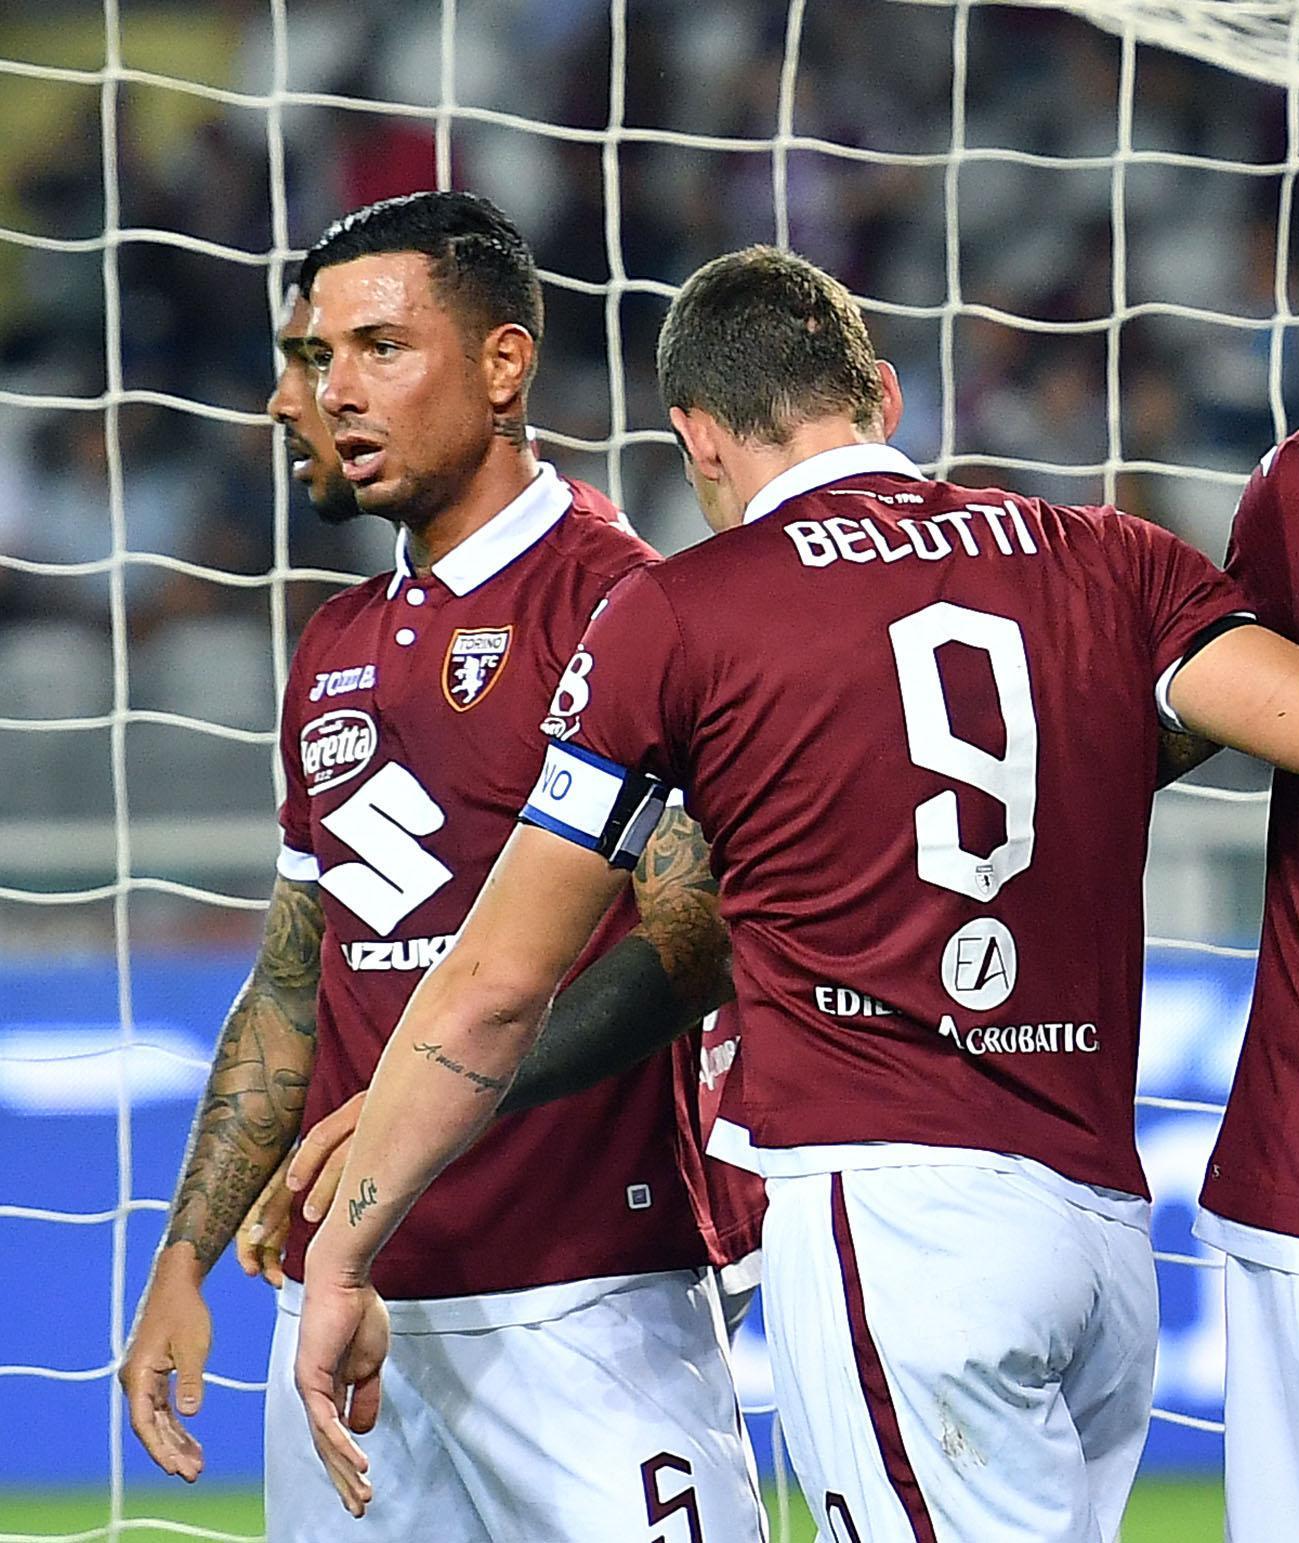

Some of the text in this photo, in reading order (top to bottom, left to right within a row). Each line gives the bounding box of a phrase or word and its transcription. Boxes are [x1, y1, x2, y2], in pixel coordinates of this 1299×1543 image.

[784, 499, 1038, 567] BELOTTI
[888, 601, 1039, 902] 9
[938, 1015, 1099, 1055] ACROBATIC
